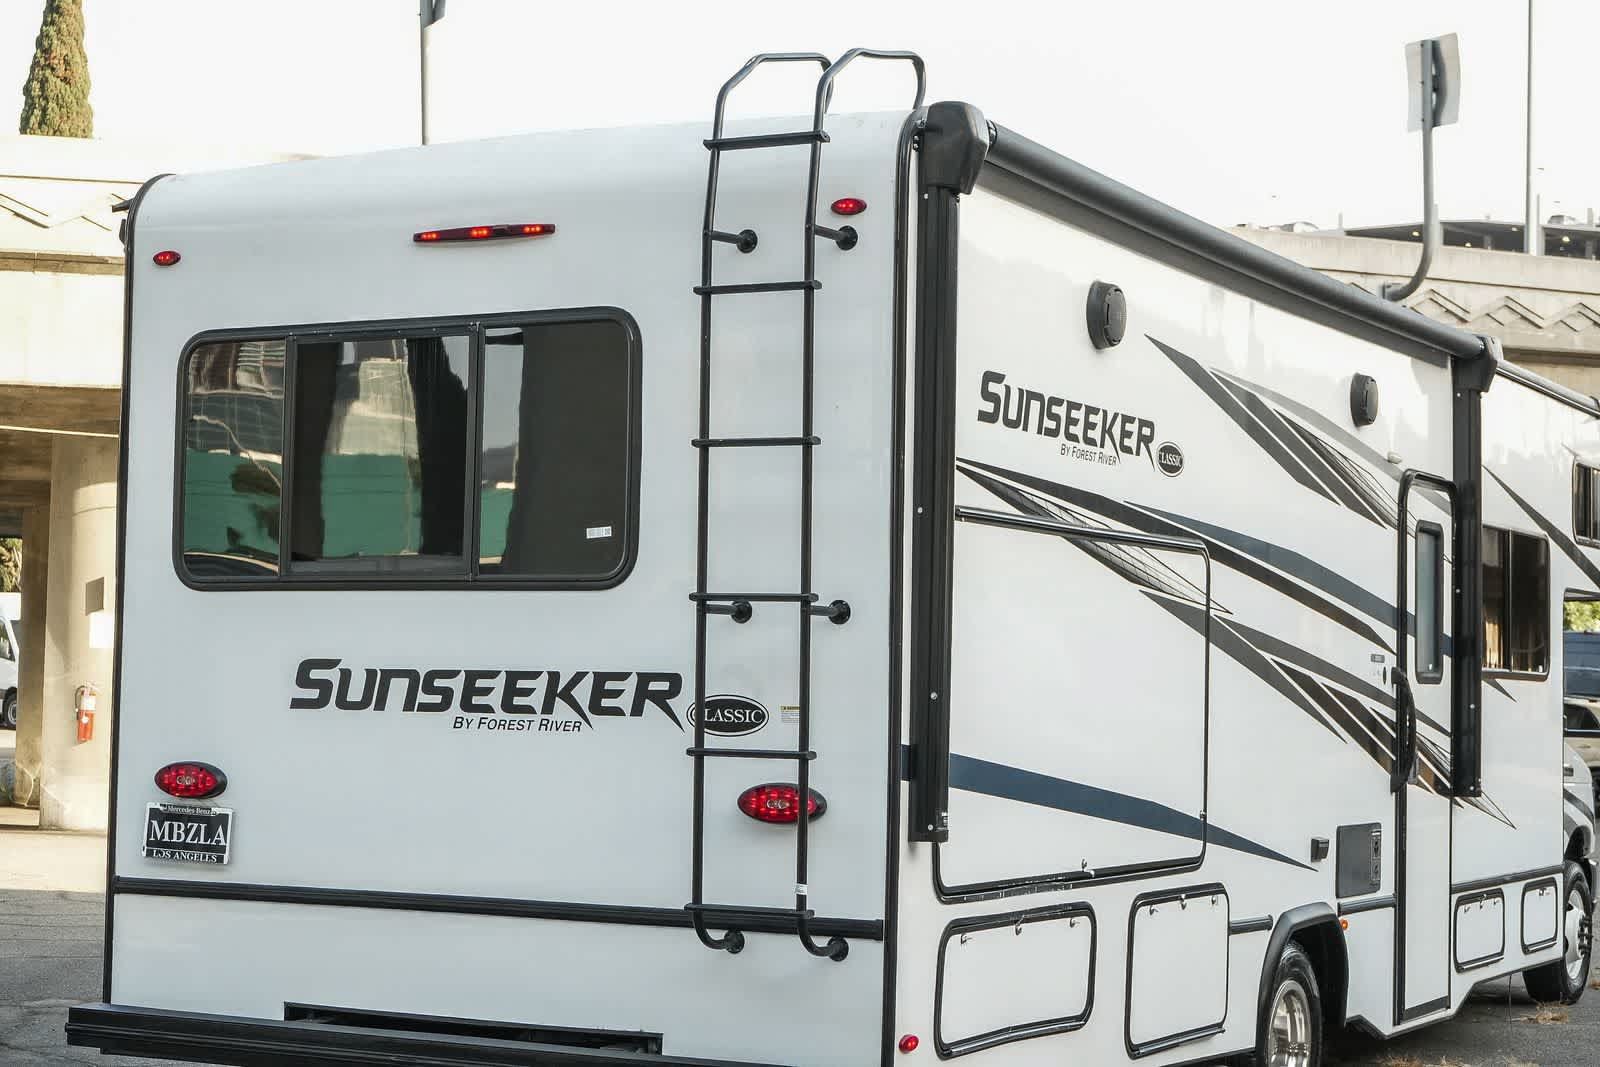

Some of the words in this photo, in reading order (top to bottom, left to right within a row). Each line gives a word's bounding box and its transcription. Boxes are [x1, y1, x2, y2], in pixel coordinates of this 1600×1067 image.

[692, 708, 763, 723] LASSIC
[149, 820, 227, 845] MBZLA
[173, 852, 217, 863] ANGELES
